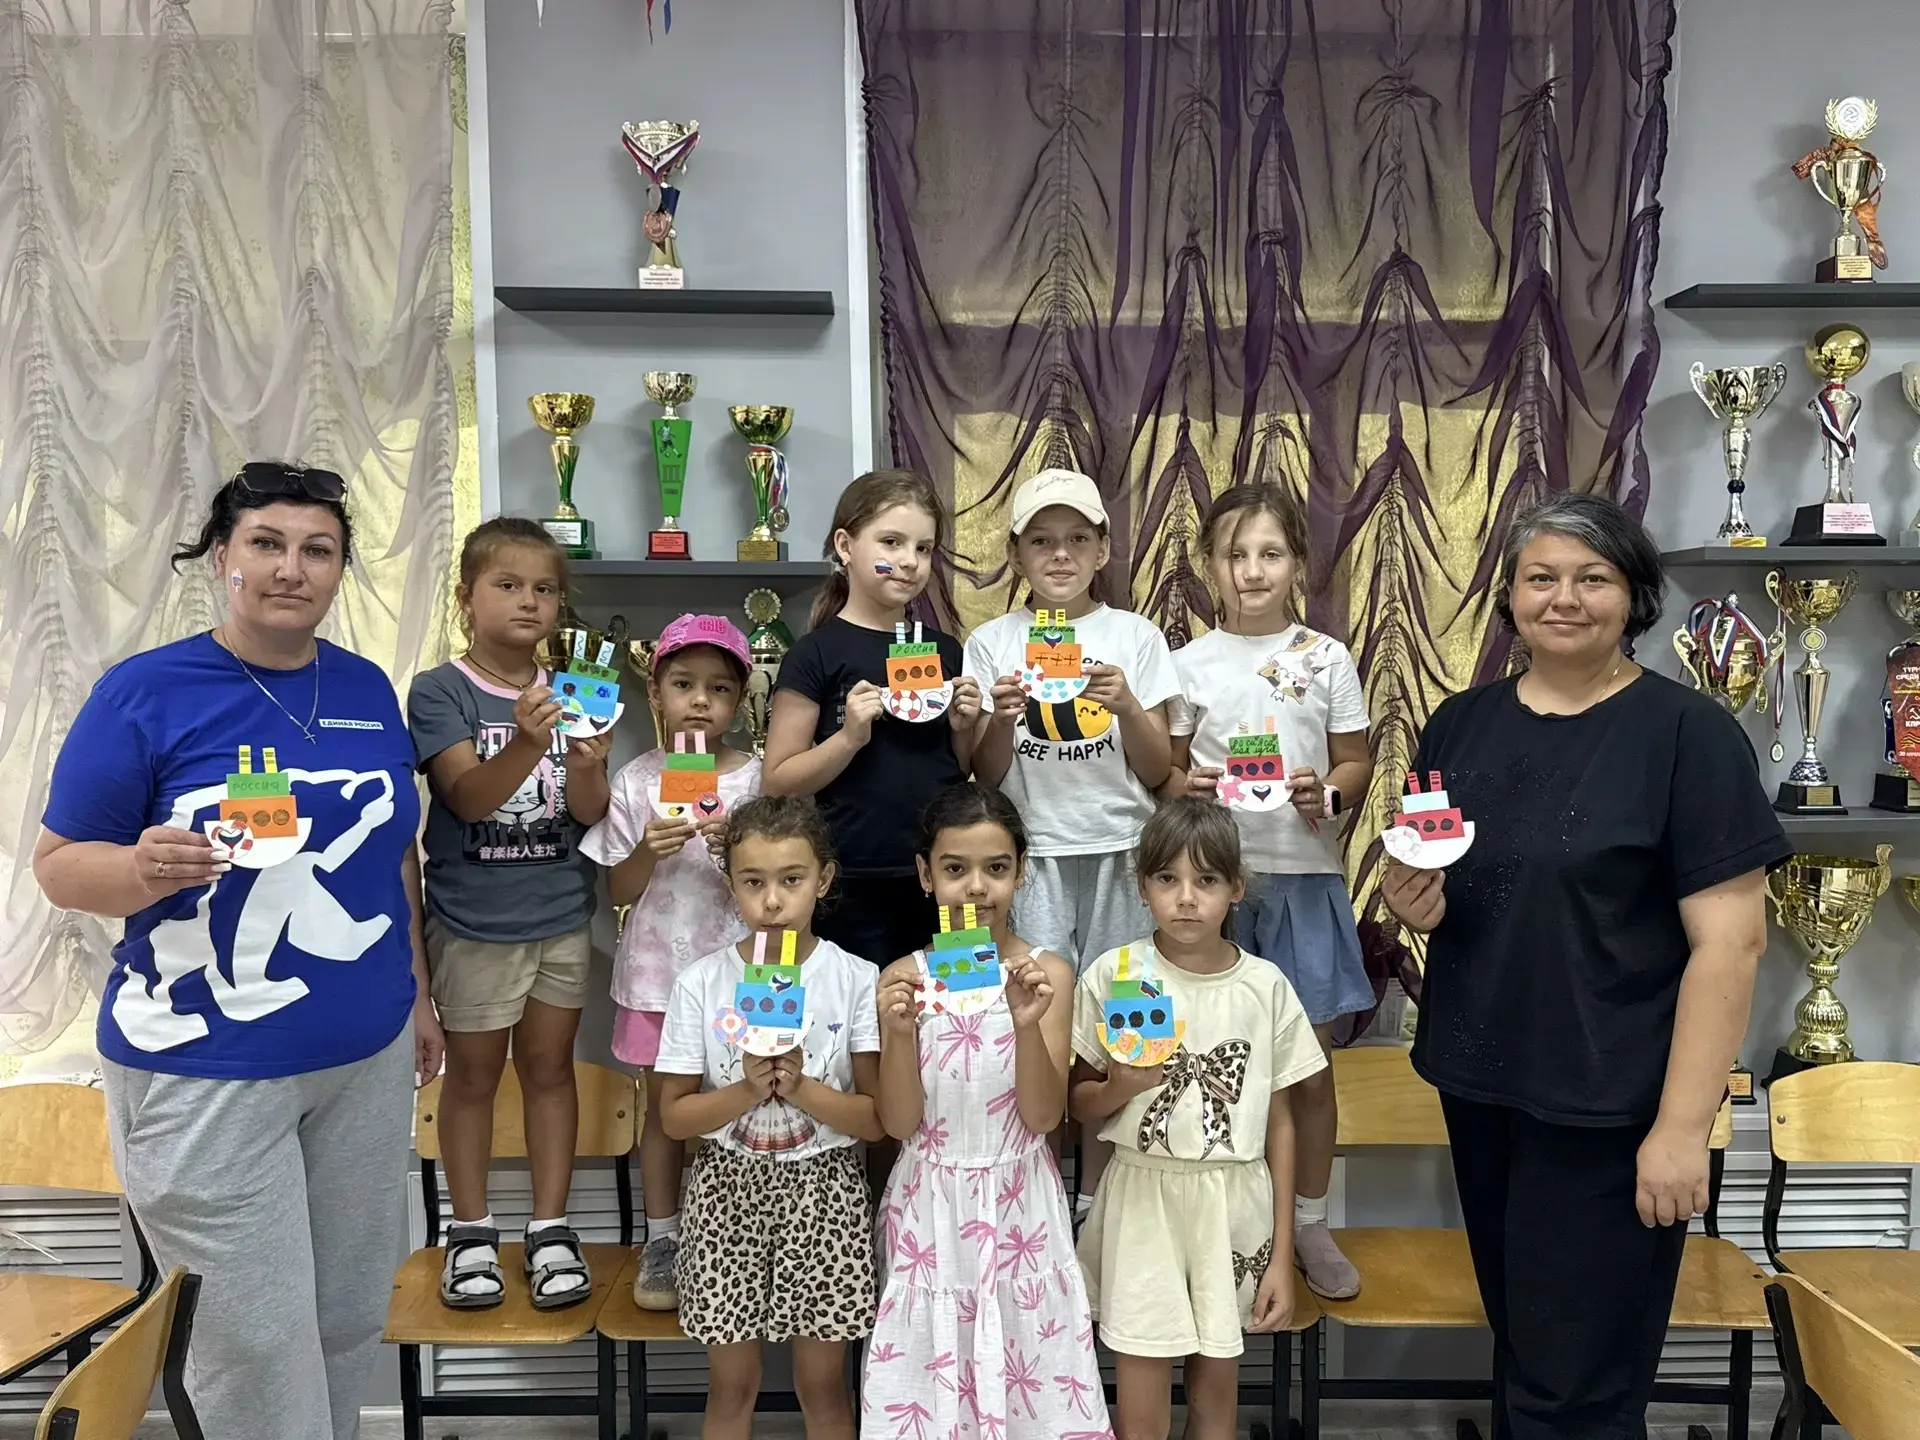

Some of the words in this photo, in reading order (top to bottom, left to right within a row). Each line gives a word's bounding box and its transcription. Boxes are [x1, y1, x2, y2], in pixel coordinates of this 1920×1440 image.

[895, 644, 934, 654] РОССИЯ
[1018, 738, 1050, 761] BEE
[1058, 734, 1116, 762] HAPPY
[232, 780, 280, 792] РОССИЯ
